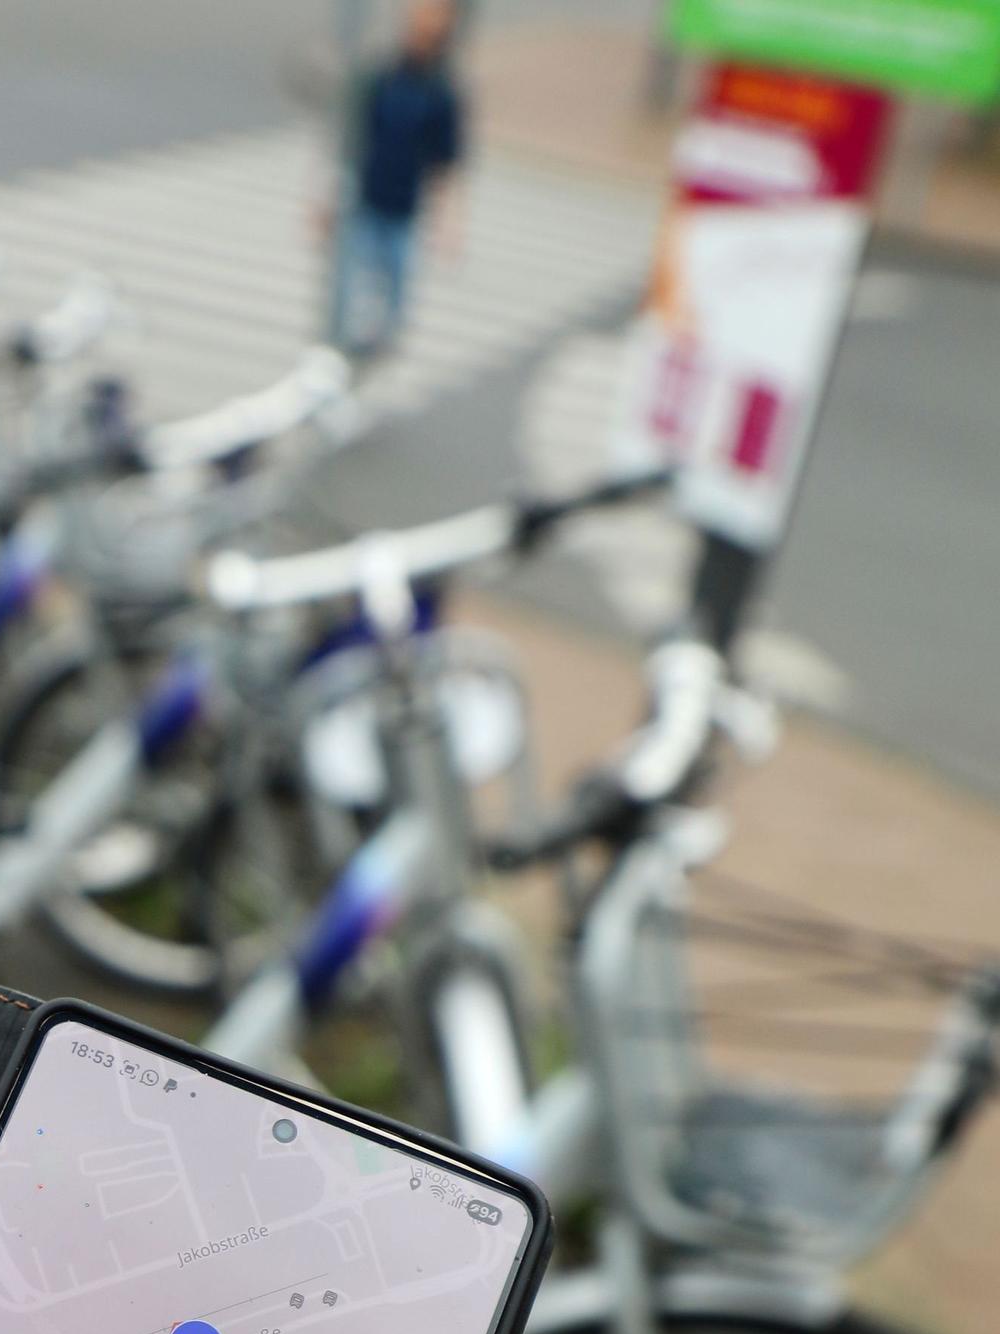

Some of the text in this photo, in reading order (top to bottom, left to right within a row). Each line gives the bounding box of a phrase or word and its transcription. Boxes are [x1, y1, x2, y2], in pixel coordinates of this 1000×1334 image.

[71, 1041, 115, 1068] 18:53
[479, 1206, 499, 1223] 94
[177, 1226, 269, 1268] Jakobstraße
